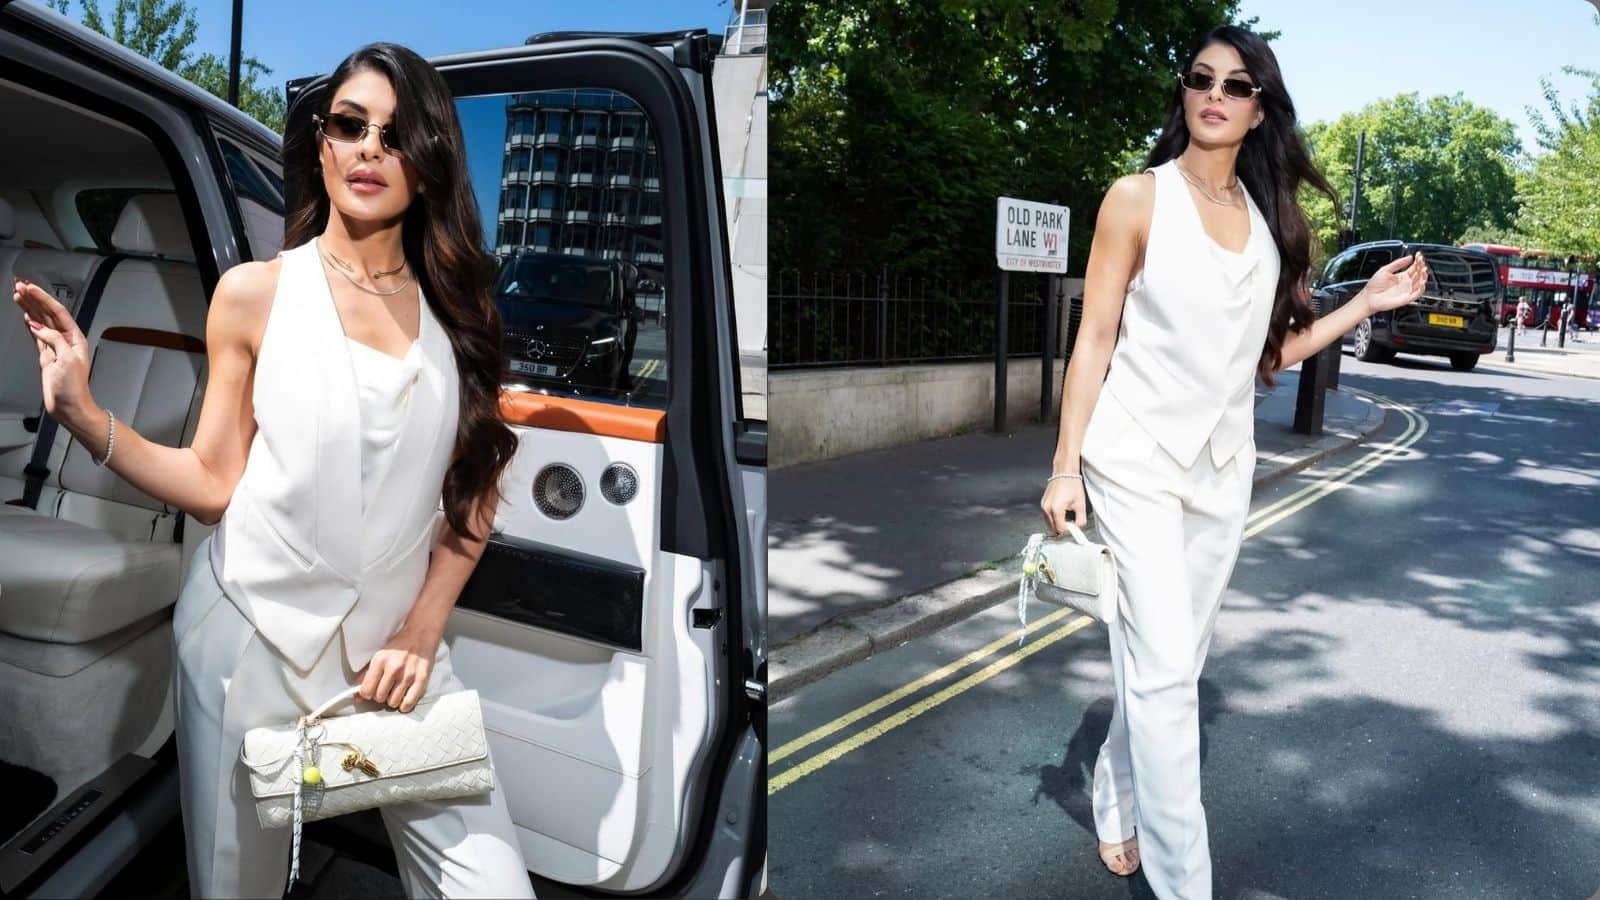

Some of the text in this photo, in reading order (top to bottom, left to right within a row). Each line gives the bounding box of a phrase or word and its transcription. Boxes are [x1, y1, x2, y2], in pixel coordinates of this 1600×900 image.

[1007, 206, 1063, 230] OLD PARK
[1007, 228, 1057, 250] LANE W1
